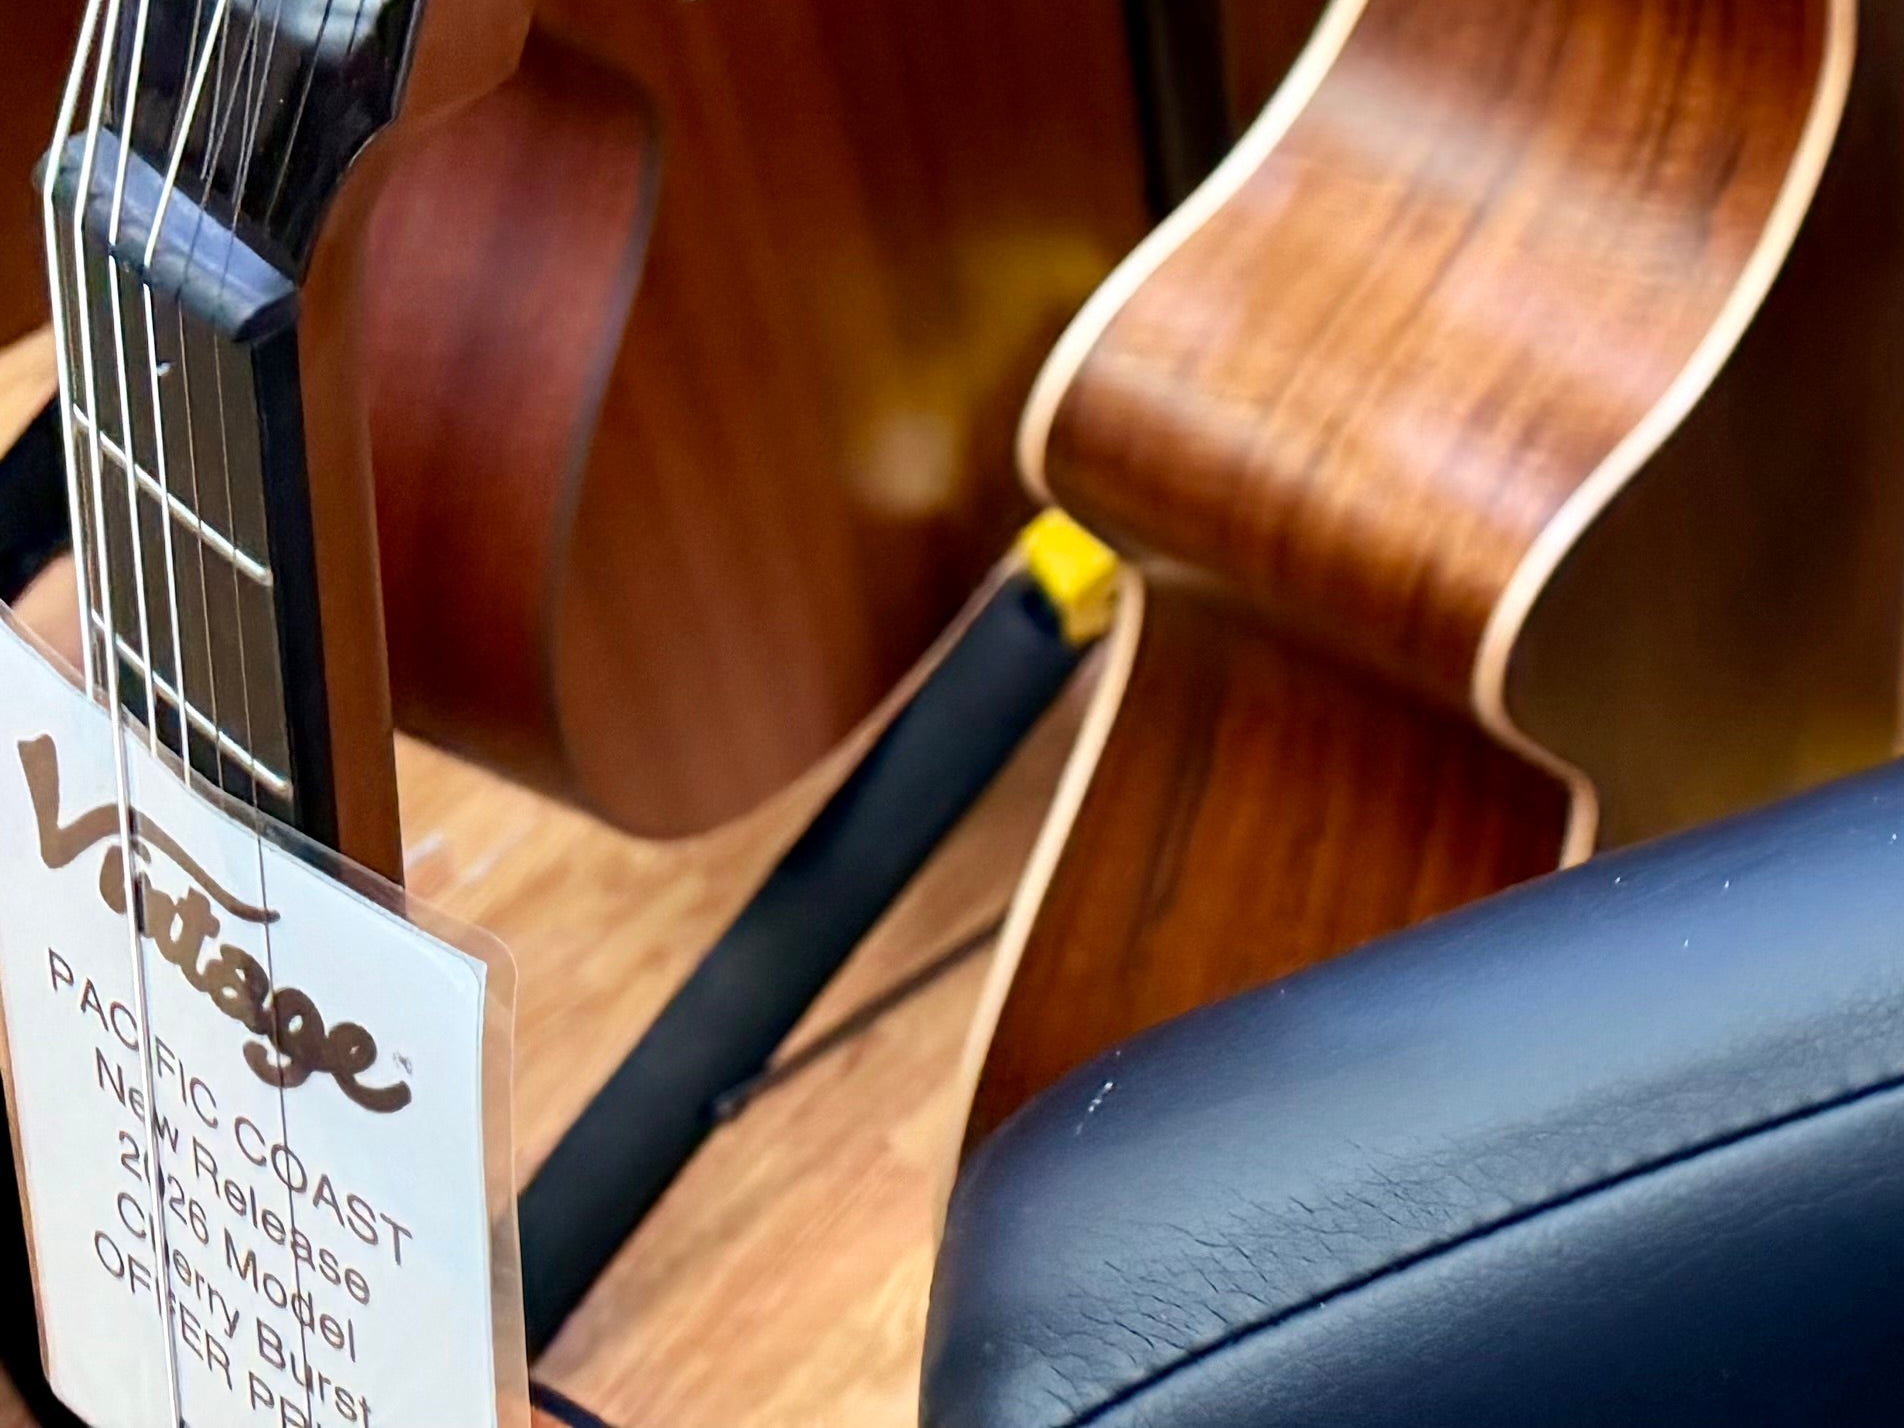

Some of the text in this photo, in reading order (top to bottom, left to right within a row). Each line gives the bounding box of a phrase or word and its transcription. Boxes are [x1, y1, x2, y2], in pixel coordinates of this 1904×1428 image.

[17, 733, 411, 1113] Vintage
[48, 948, 413, 1265] PACFIC COAST
[95, 1047, 370, 1305] New Release
[94, 1230, 232, 1391] OFFER
[224, 1227, 356, 1363] Model
[256, 1316, 372, 1428] Burst
